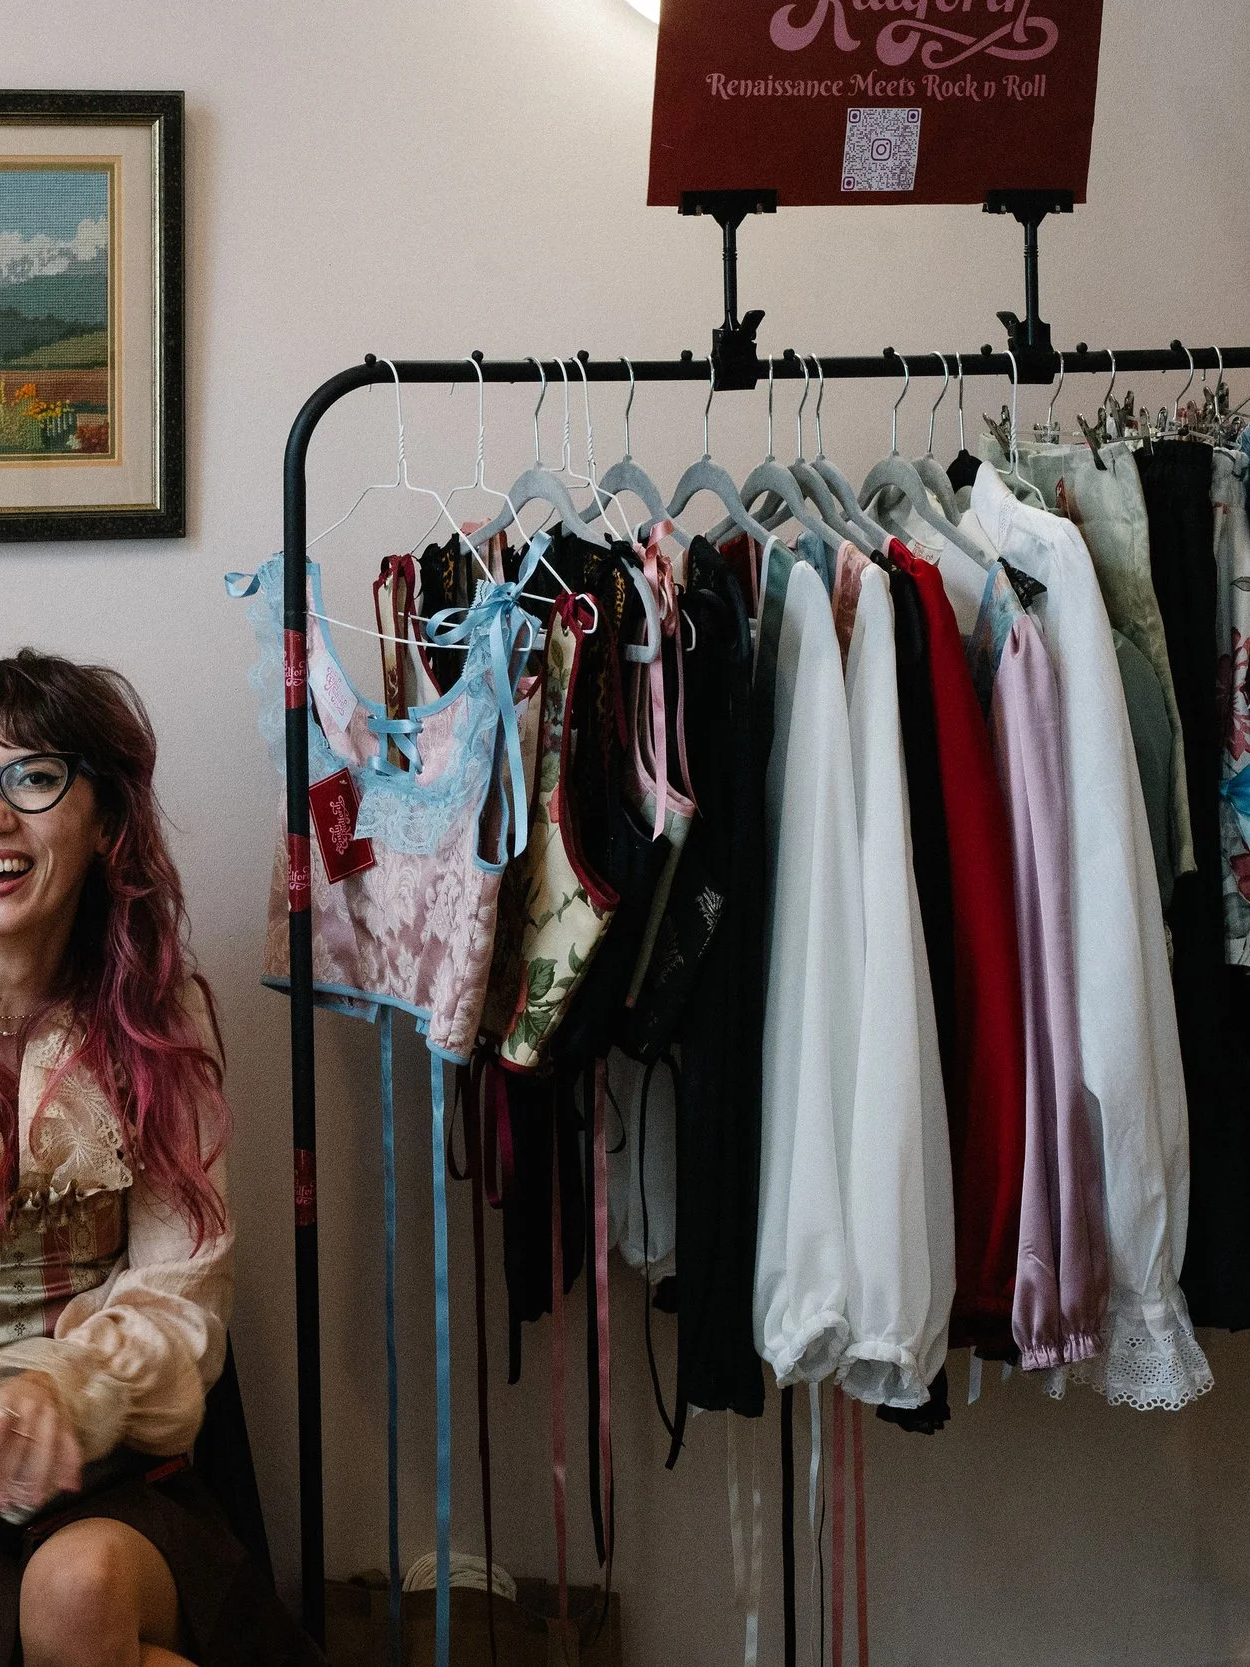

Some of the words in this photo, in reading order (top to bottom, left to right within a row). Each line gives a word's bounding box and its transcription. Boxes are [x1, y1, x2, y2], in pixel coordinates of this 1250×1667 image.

[705, 73, 843, 100] Renaissance
[848, 69, 916, 97] Meets
[922, 73, 981, 101] Rock
[983, 81, 996, 99] n
[1003, 74, 1047, 100] Roll
